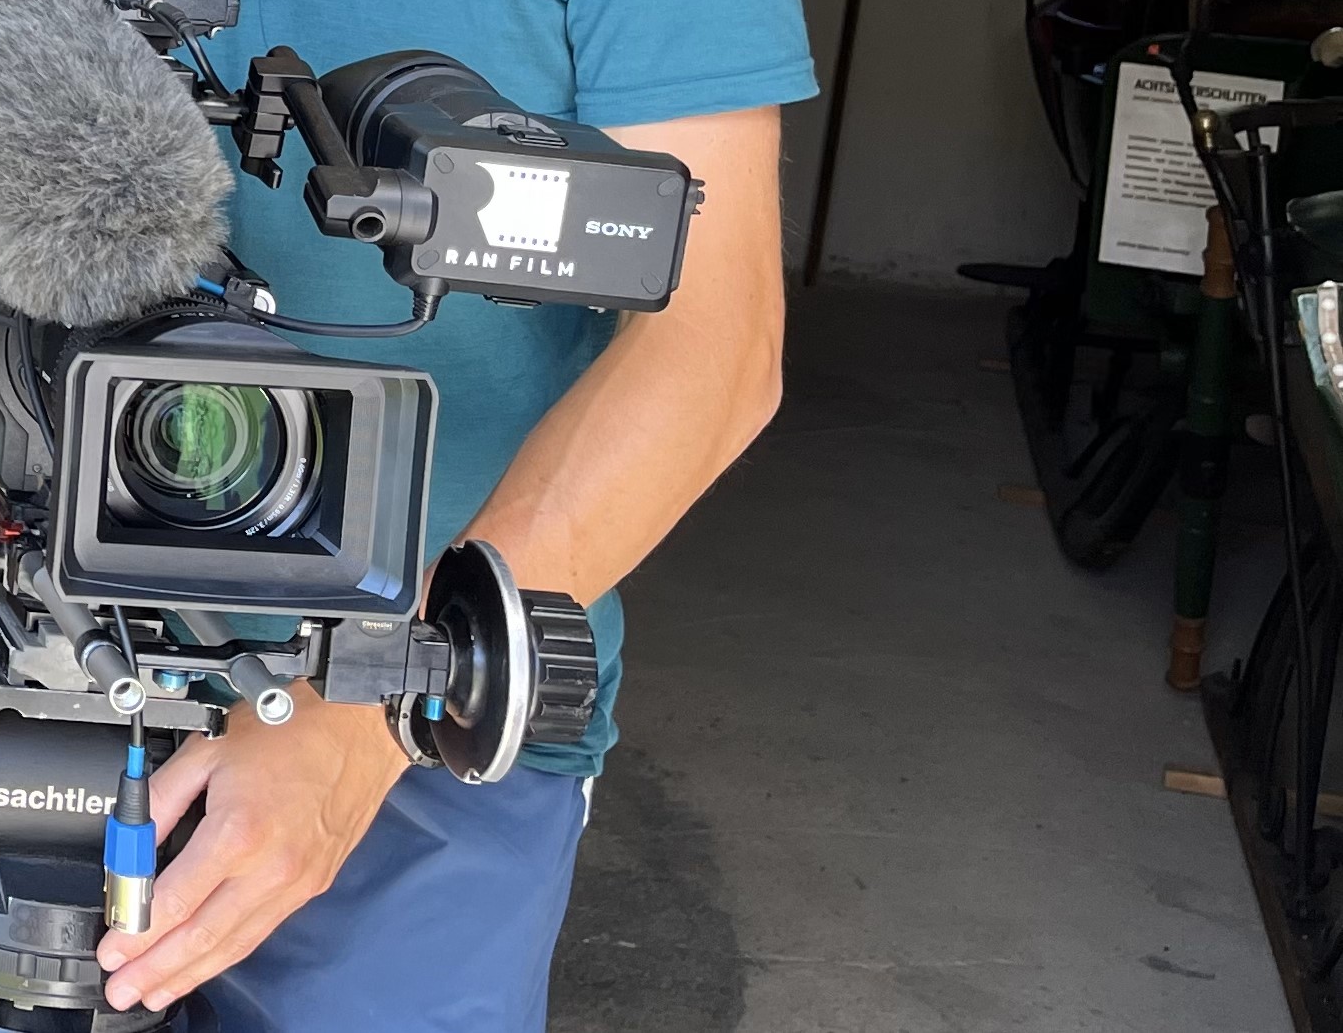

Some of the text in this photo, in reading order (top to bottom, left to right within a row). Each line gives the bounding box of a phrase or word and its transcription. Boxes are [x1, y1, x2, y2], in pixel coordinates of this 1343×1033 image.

[585, 220, 653, 239] SONY
[445, 249, 575, 277] RAN FILM
